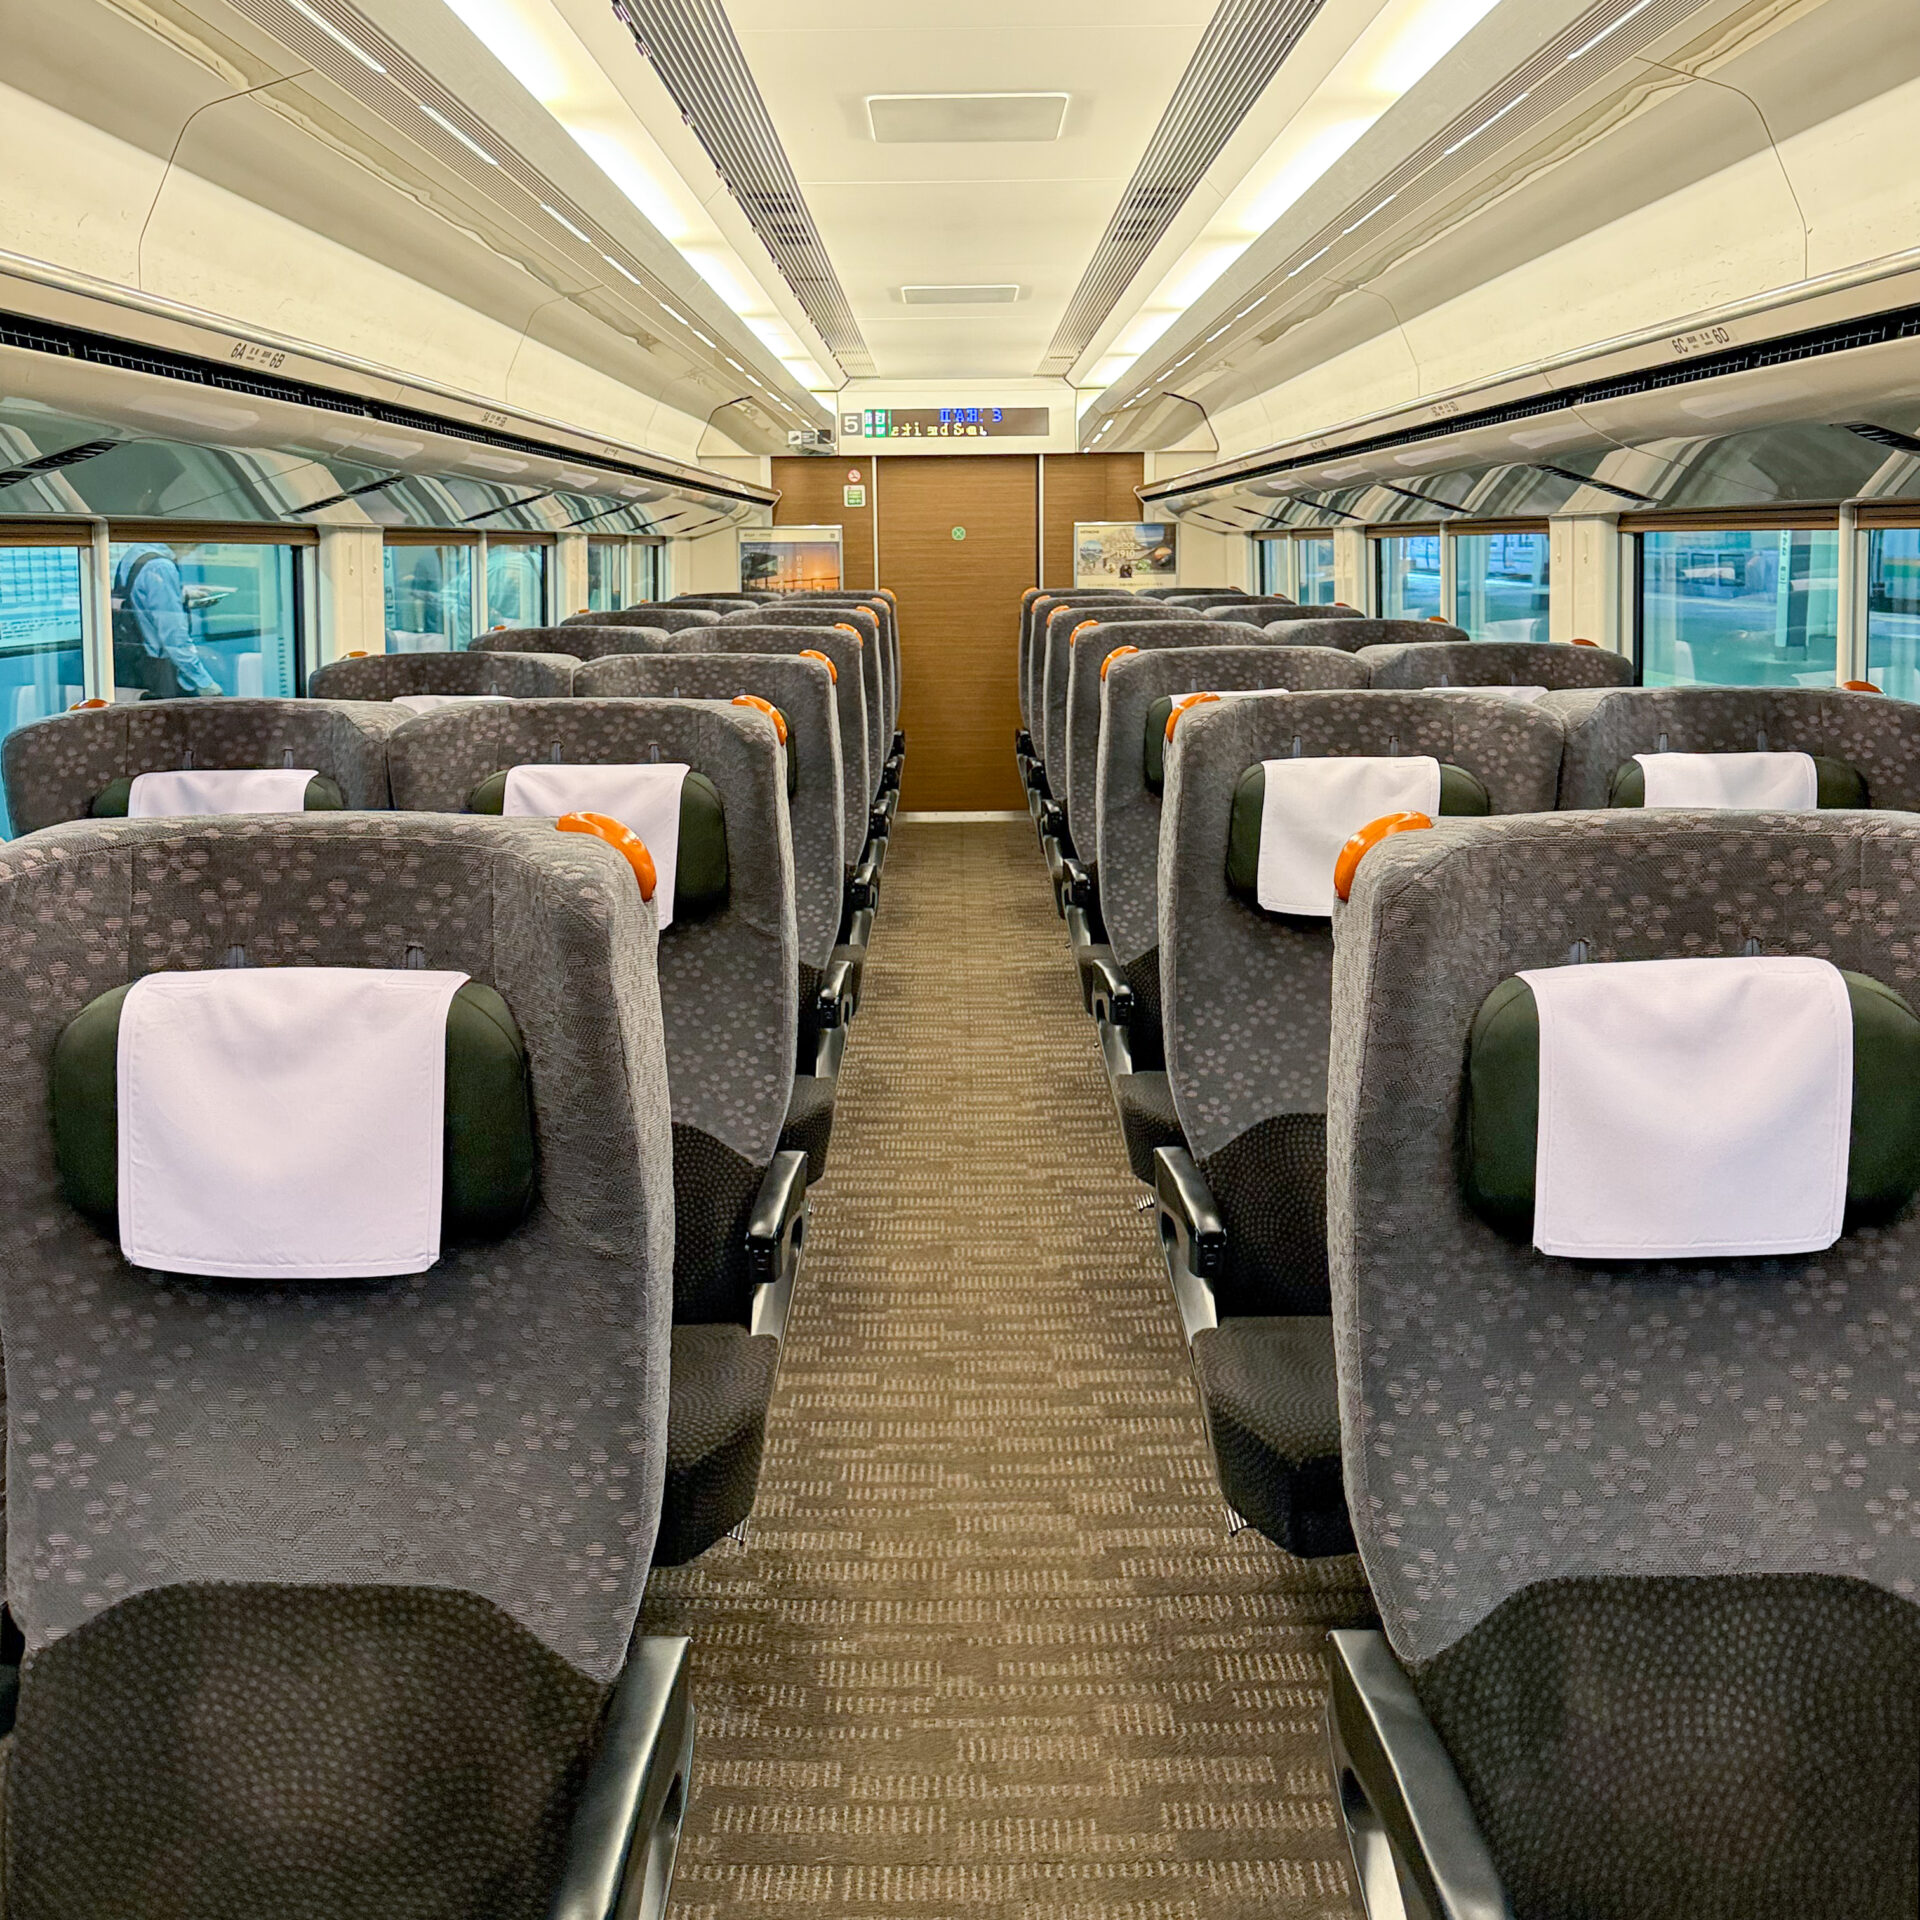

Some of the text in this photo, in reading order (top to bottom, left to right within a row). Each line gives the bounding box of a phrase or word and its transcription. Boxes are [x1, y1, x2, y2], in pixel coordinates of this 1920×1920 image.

[1671, 338, 1688, 354] 6C
[1712, 327, 1729, 344] 6D
[231, 343, 247, 359] 6A
[270, 353, 285, 368] 6B
[844, 415, 858, 433] 5
[1116, 549, 1136, 557] 1910
